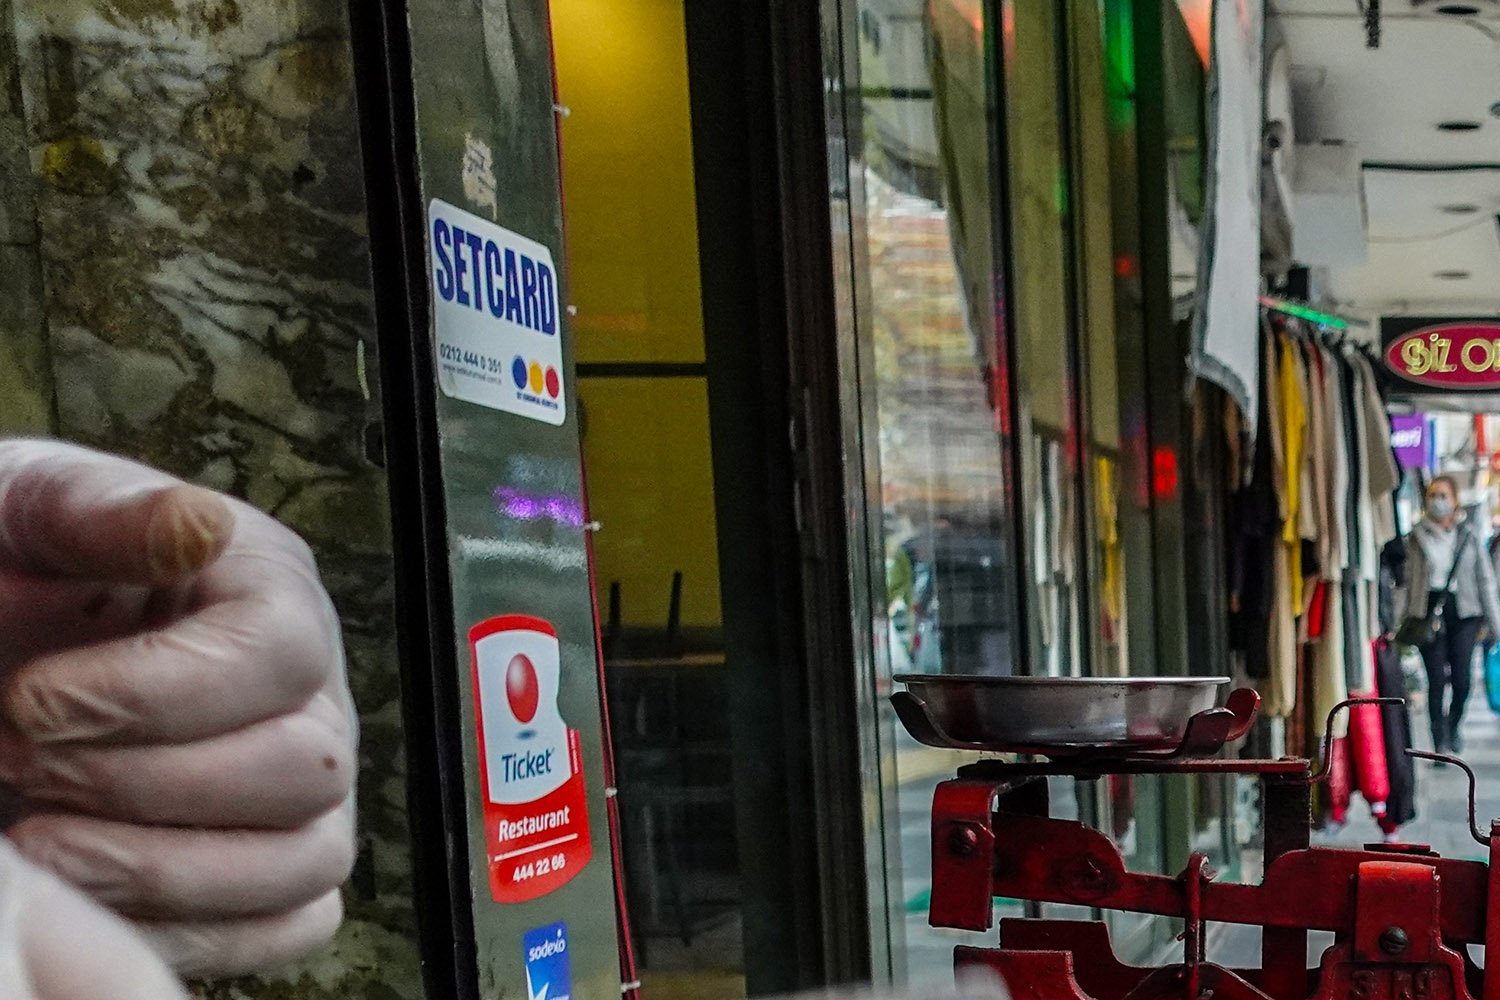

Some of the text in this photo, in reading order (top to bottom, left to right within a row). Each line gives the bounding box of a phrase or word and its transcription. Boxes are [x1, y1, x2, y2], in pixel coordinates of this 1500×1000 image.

[434, 218, 556, 335] SETCARD
[440, 343, 461, 363] 0212
[463, 351, 479, 367] 444
[502, 749, 552, 783] Ticket
[499, 805, 570, 842] Restaurant
[513, 862, 534, 882] 444
[536, 857, 551, 876] 22
[529, 938, 566, 962] sodexo
